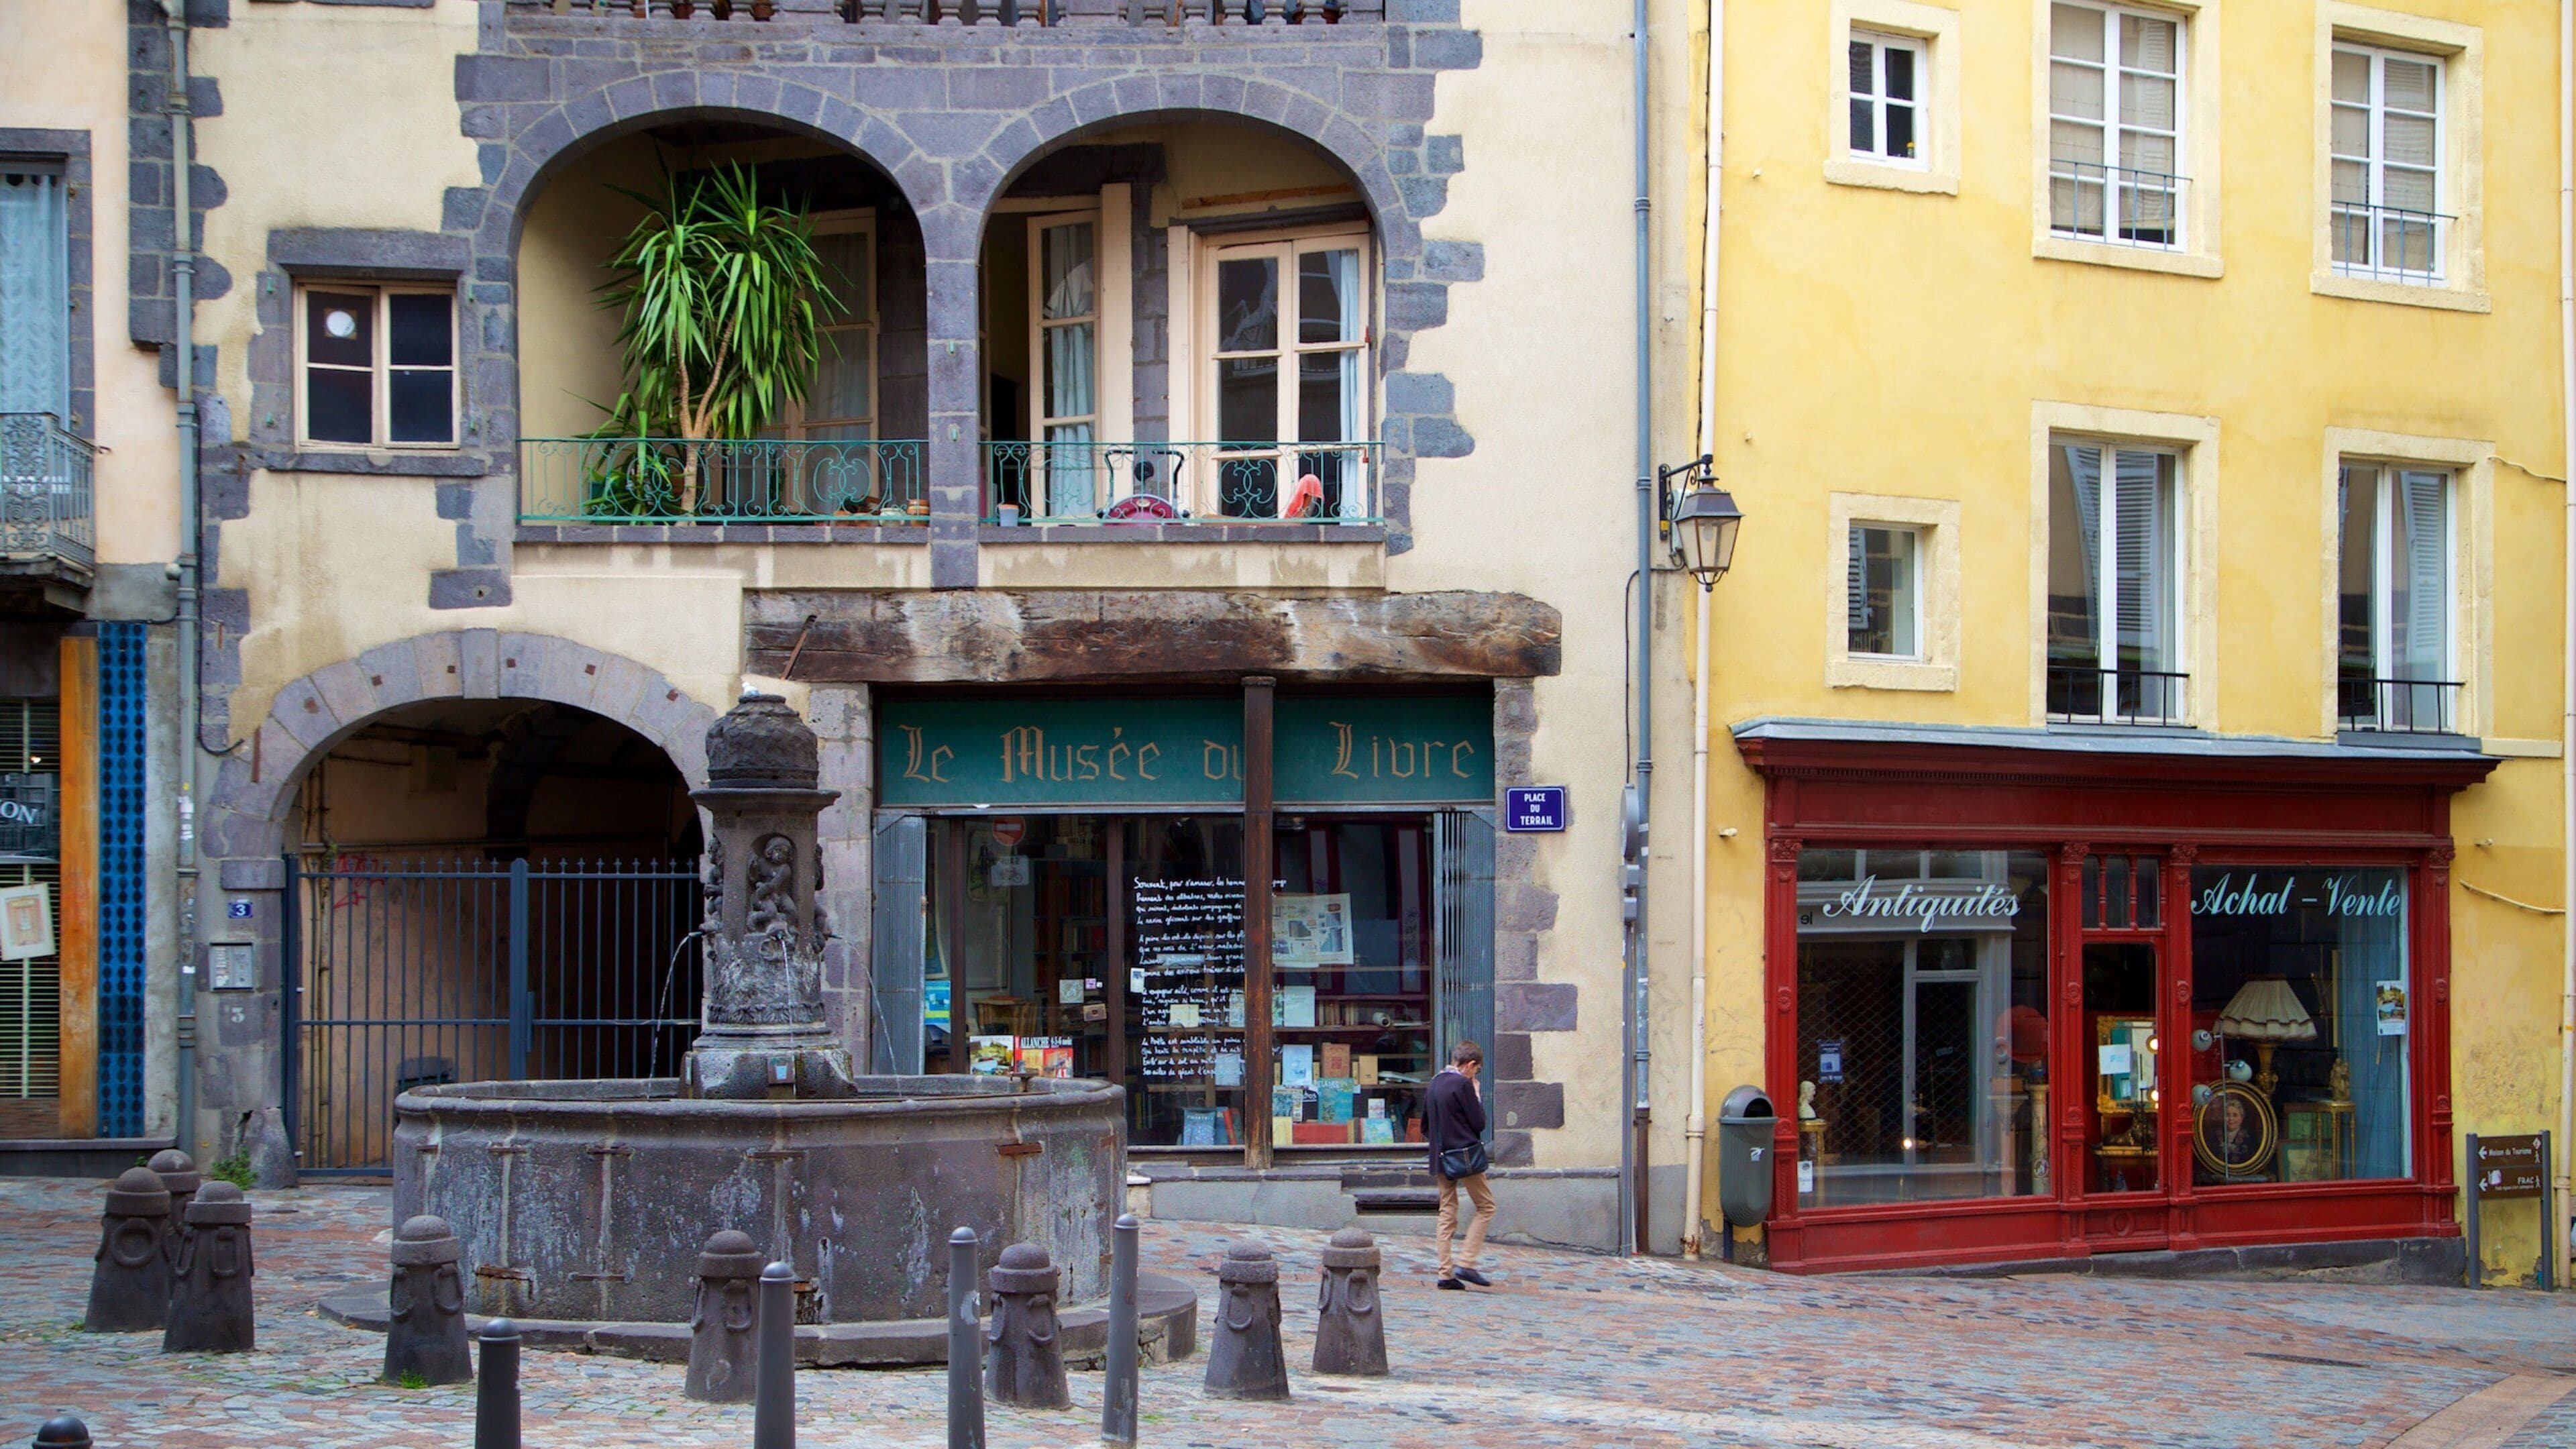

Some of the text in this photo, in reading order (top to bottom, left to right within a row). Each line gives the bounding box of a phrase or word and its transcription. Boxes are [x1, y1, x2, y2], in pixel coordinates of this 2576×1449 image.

[898, 724, 956, 784] Le
[1000, 724, 1163, 784] Musée
[1329, 721, 1474, 779] Livre
[1523, 793, 1546, 802] PLACE
[0, 800, 38, 824] ON
[1529, 804, 1540, 813] DU
[1520, 815, 1554, 826] TERRAIL
[2190, 872, 2296, 916] Achat
[2321, 874, 2402, 916] Vente
[1823, 874, 2021, 933] Antiquités
[235, 904, 246, 916] 3
[231, 1007, 245, 1023] 3
[1020, 1036, 1049, 1049] ALLANCHE
[2489, 1147, 2532, 1157] Maison du Tourisme
[2518, 1176, 2534, 1185] FRAC
